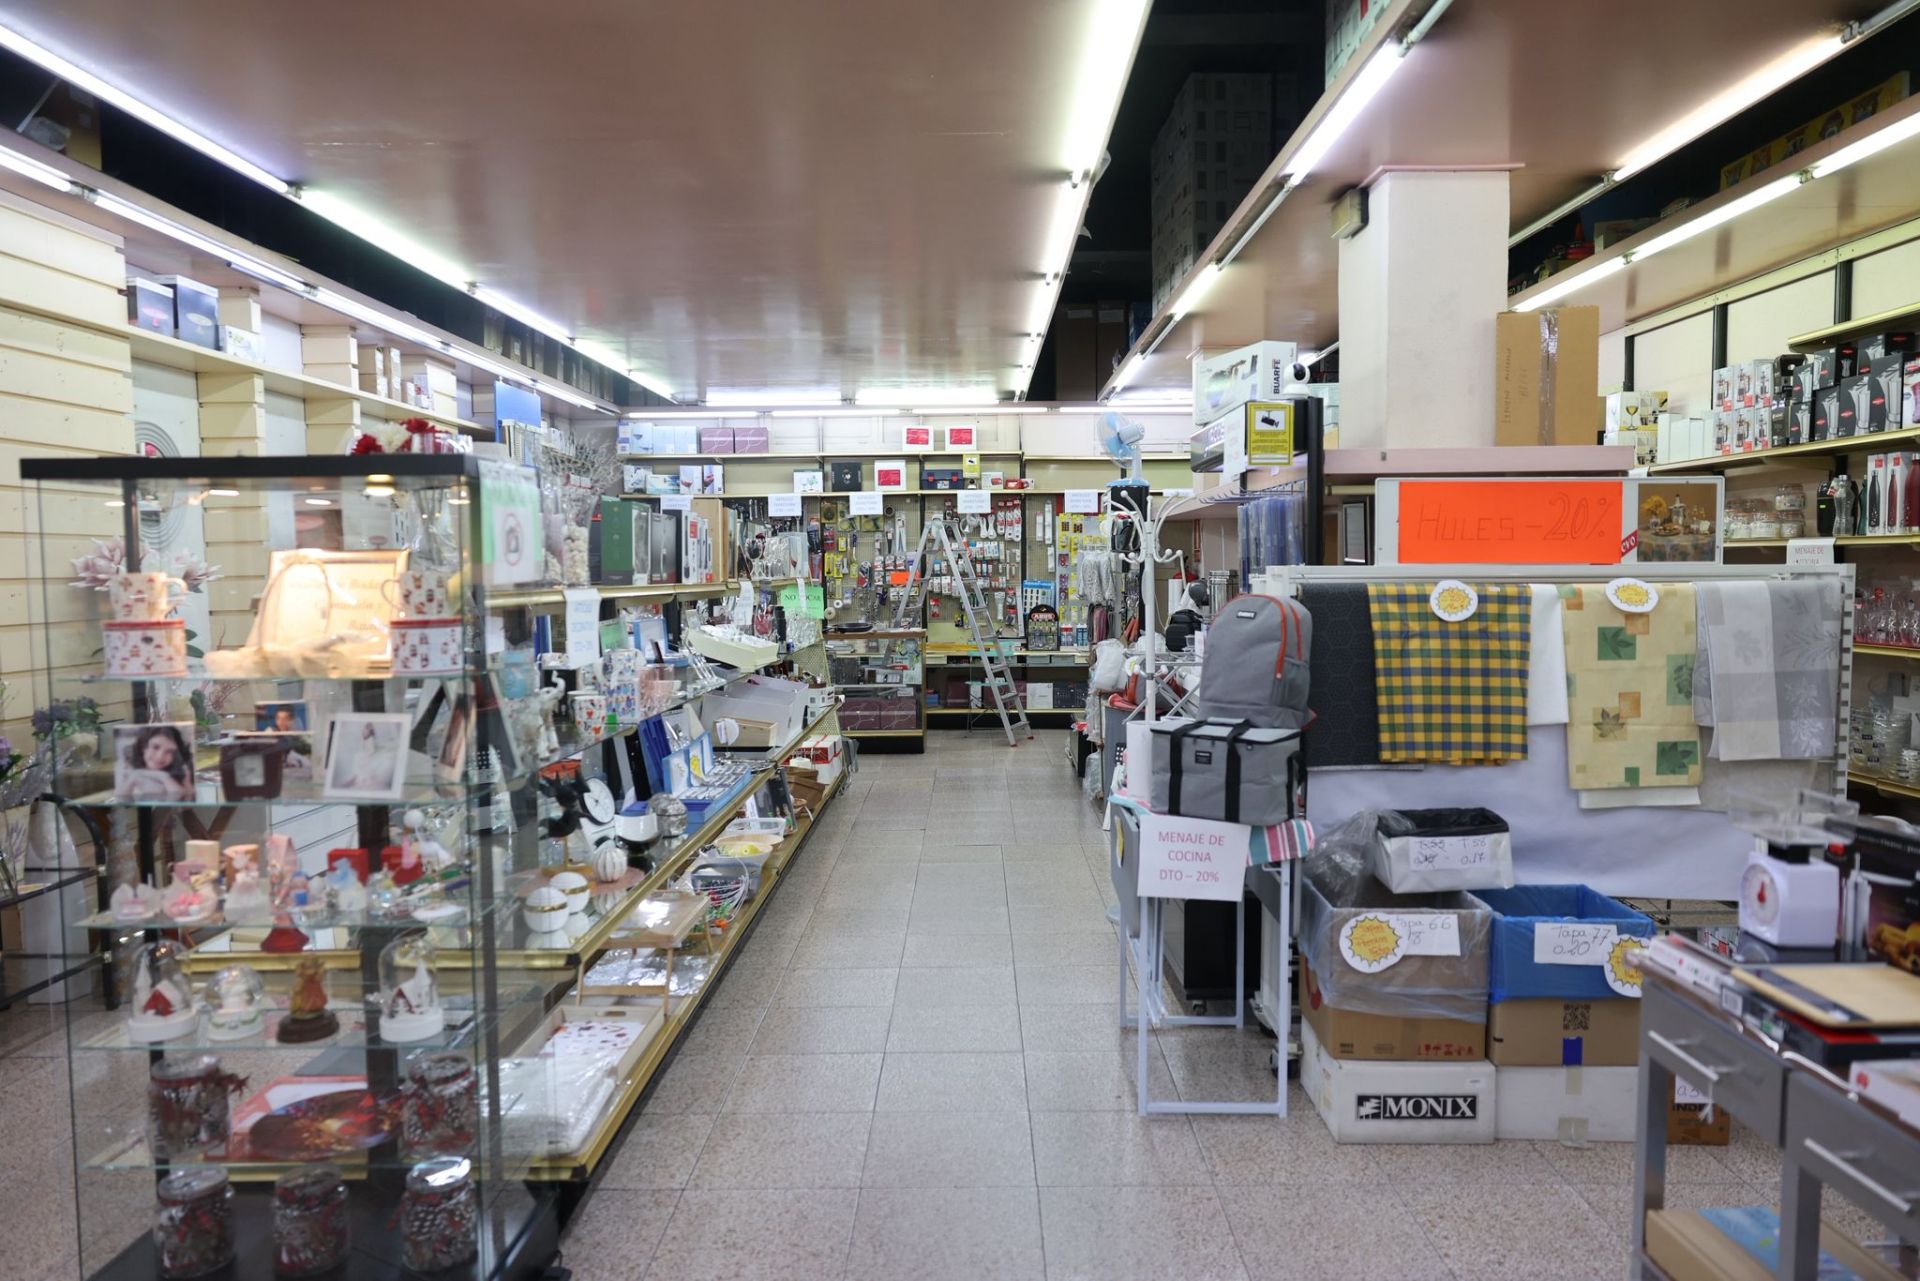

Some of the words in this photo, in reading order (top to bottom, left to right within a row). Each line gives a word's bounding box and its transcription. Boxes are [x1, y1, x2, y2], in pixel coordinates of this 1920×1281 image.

[1158, 831, 1204, 844] MENAJE
[1209, 835, 1224, 846] DE
[1168, 850, 1211, 862] COCINA
[1160, 869, 1183, 881] DTO
[1196, 870, 1219, 882] 20%
[1385, 1097, 1474, 1117] MONIX
